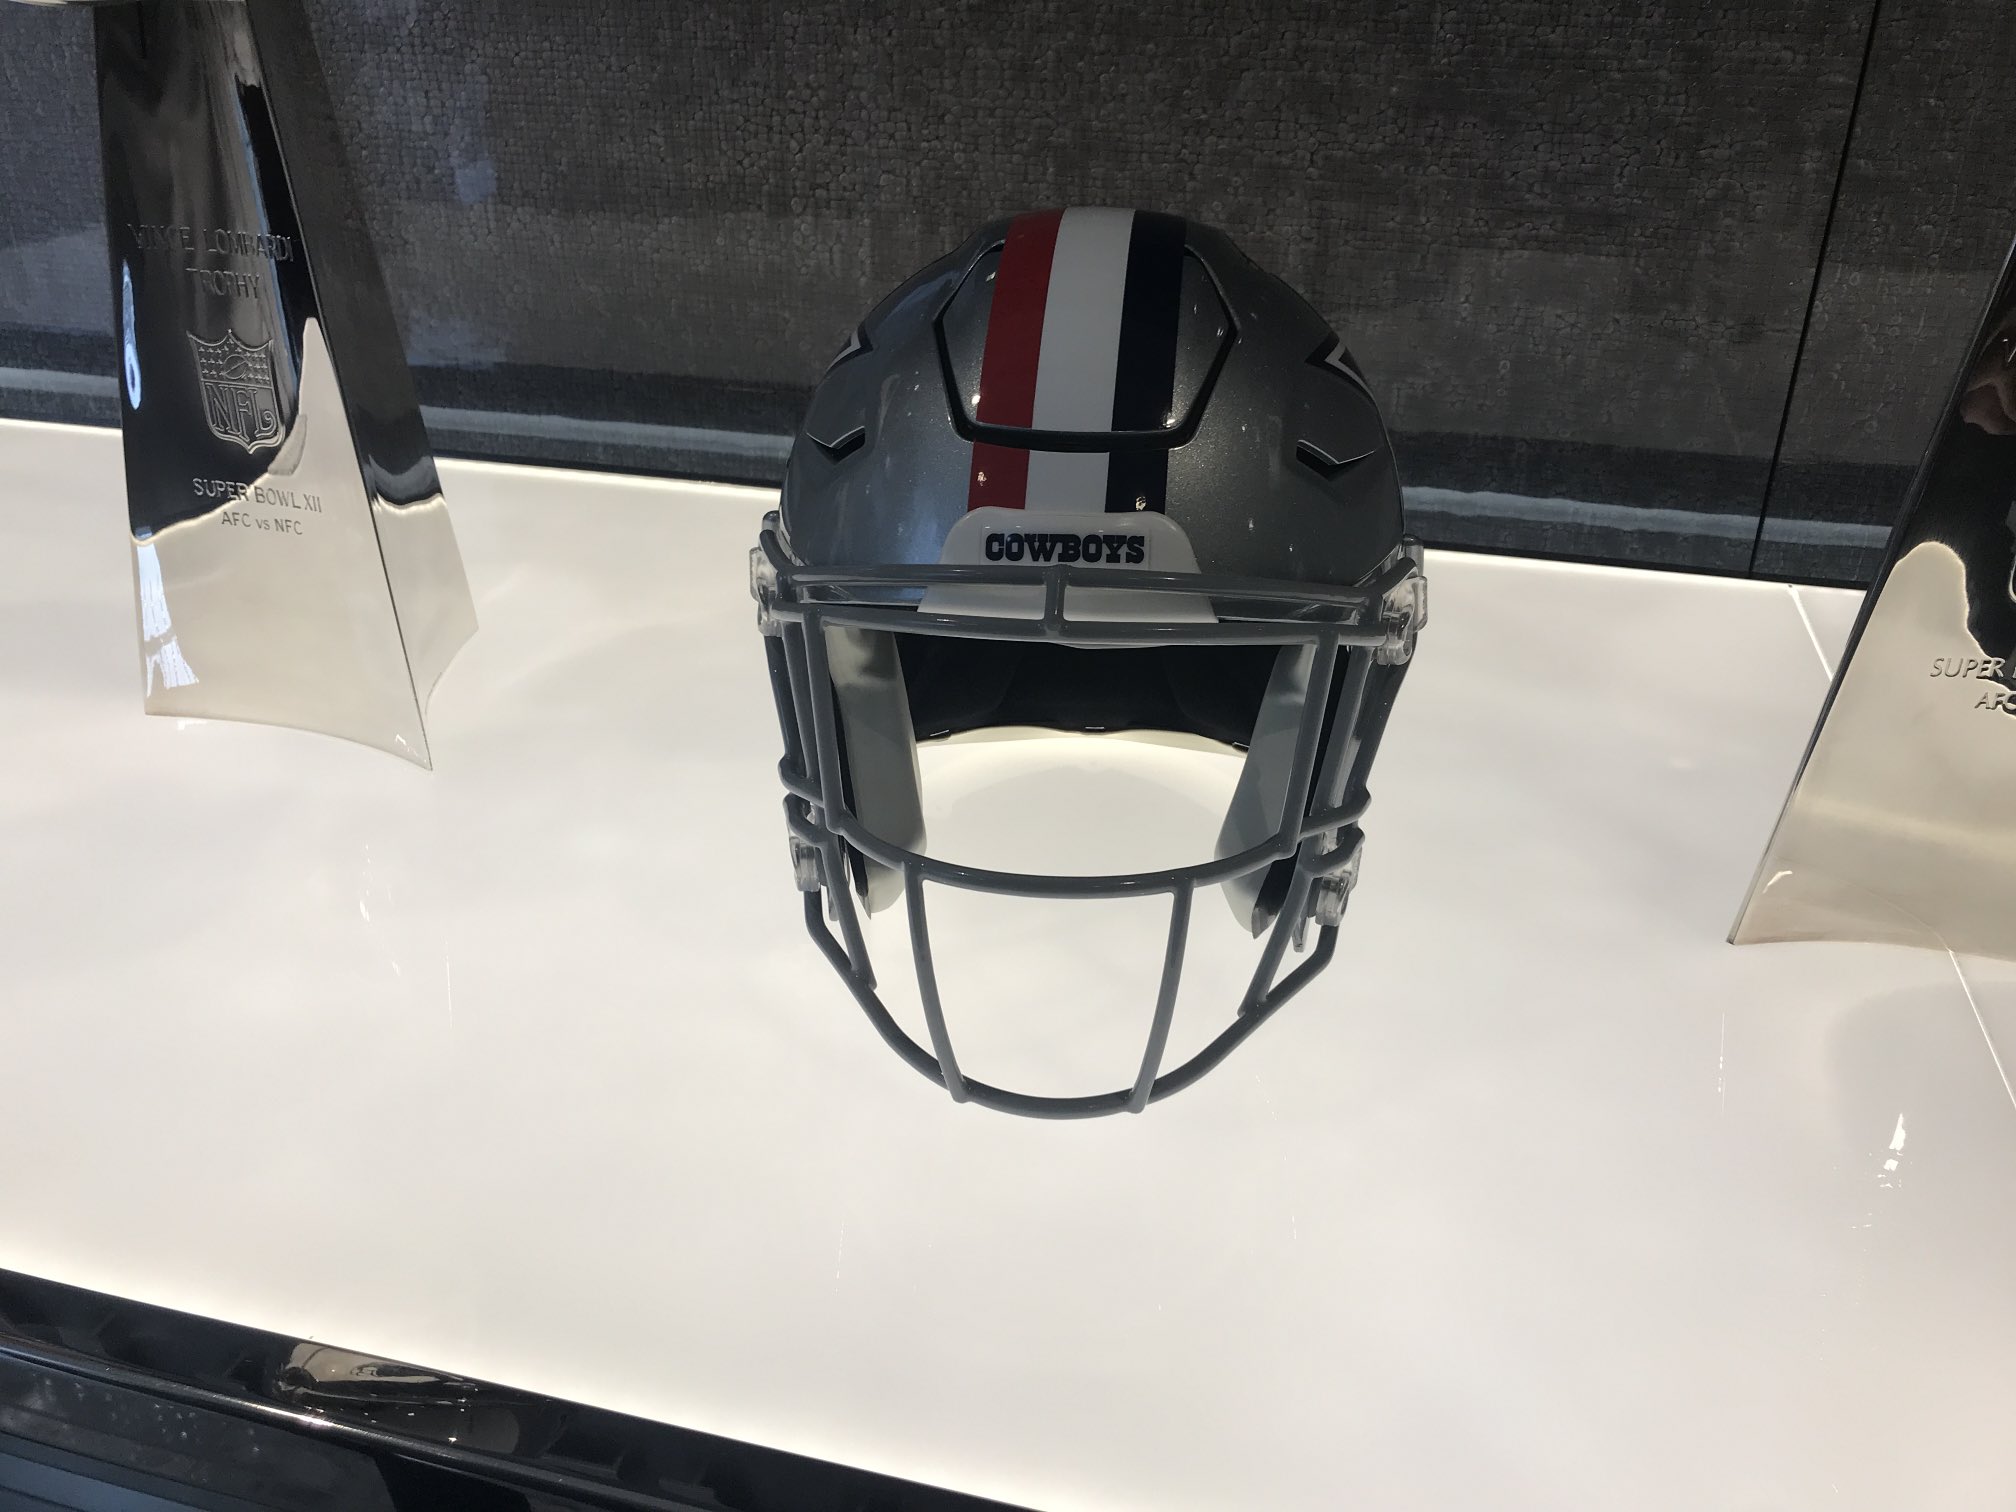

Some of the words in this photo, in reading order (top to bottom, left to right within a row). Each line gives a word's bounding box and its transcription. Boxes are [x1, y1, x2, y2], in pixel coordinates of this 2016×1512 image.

[203, 228, 294, 262] LOMBARDI
[185, 266, 259, 299] TROPHY
[204, 382, 277, 442] NFL
[192, 477, 248, 501] SUPER
[254, 486, 301, 509] BOWL
[303, 493, 322, 513] XII
[221, 511, 251, 528] AFC
[255, 519, 271, 531] vs
[274, 518, 303, 535] NFC
[985, 532, 1145, 564] COWBOYS
[1929, 657, 2006, 680] SUPER
